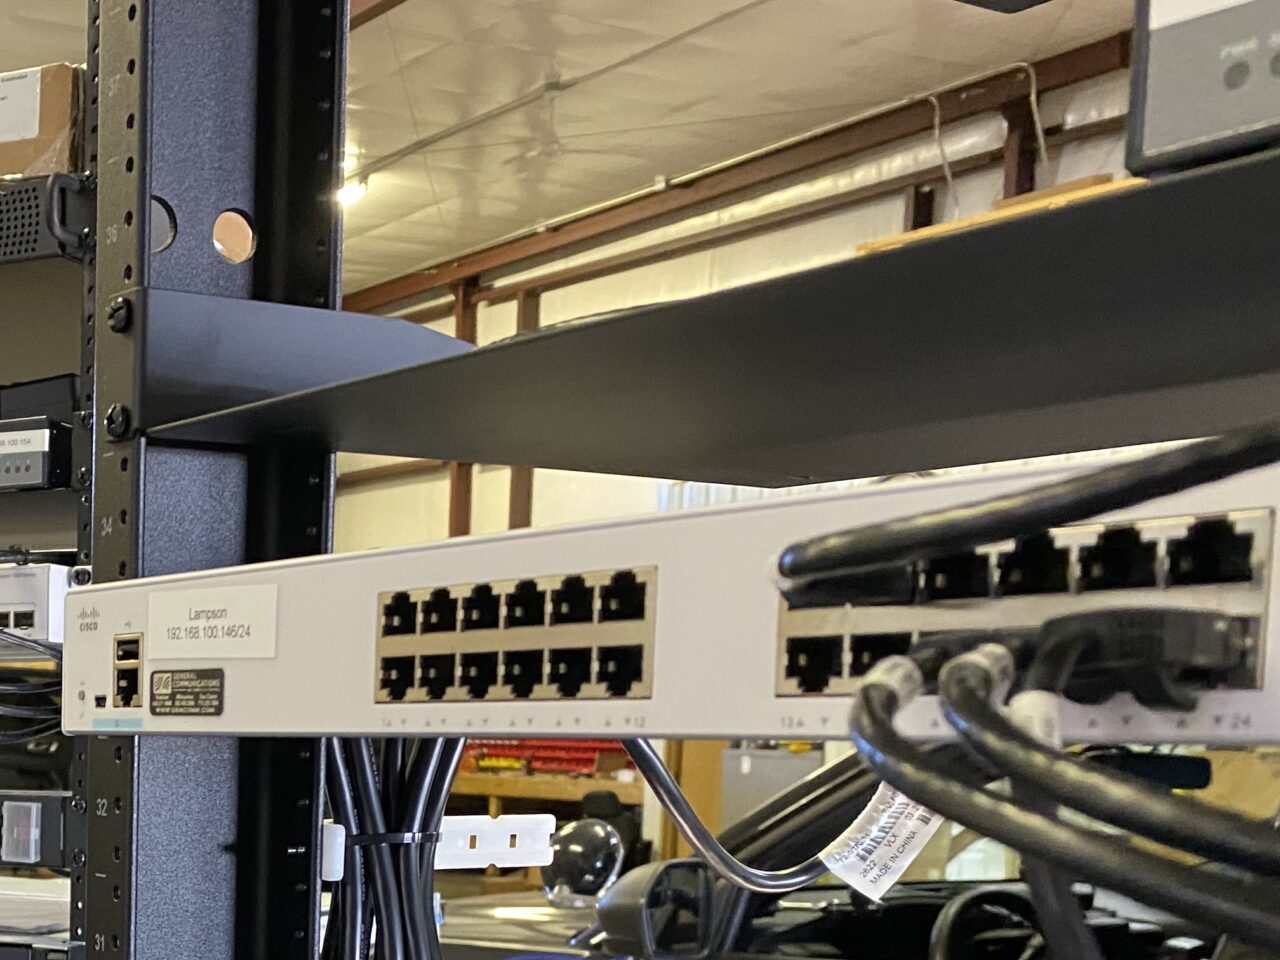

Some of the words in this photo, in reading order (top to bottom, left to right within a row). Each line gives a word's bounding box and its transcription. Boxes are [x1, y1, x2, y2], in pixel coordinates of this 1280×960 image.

[188, 607, 227, 622] Lampson
[166, 624, 251, 641] 192.168.100.146/24
[96, 797, 108, 817] 32
[870, 863, 893, 886] MADE
[896, 830, 918, 855] CHINA
[94, 933, 105, 952] 31
